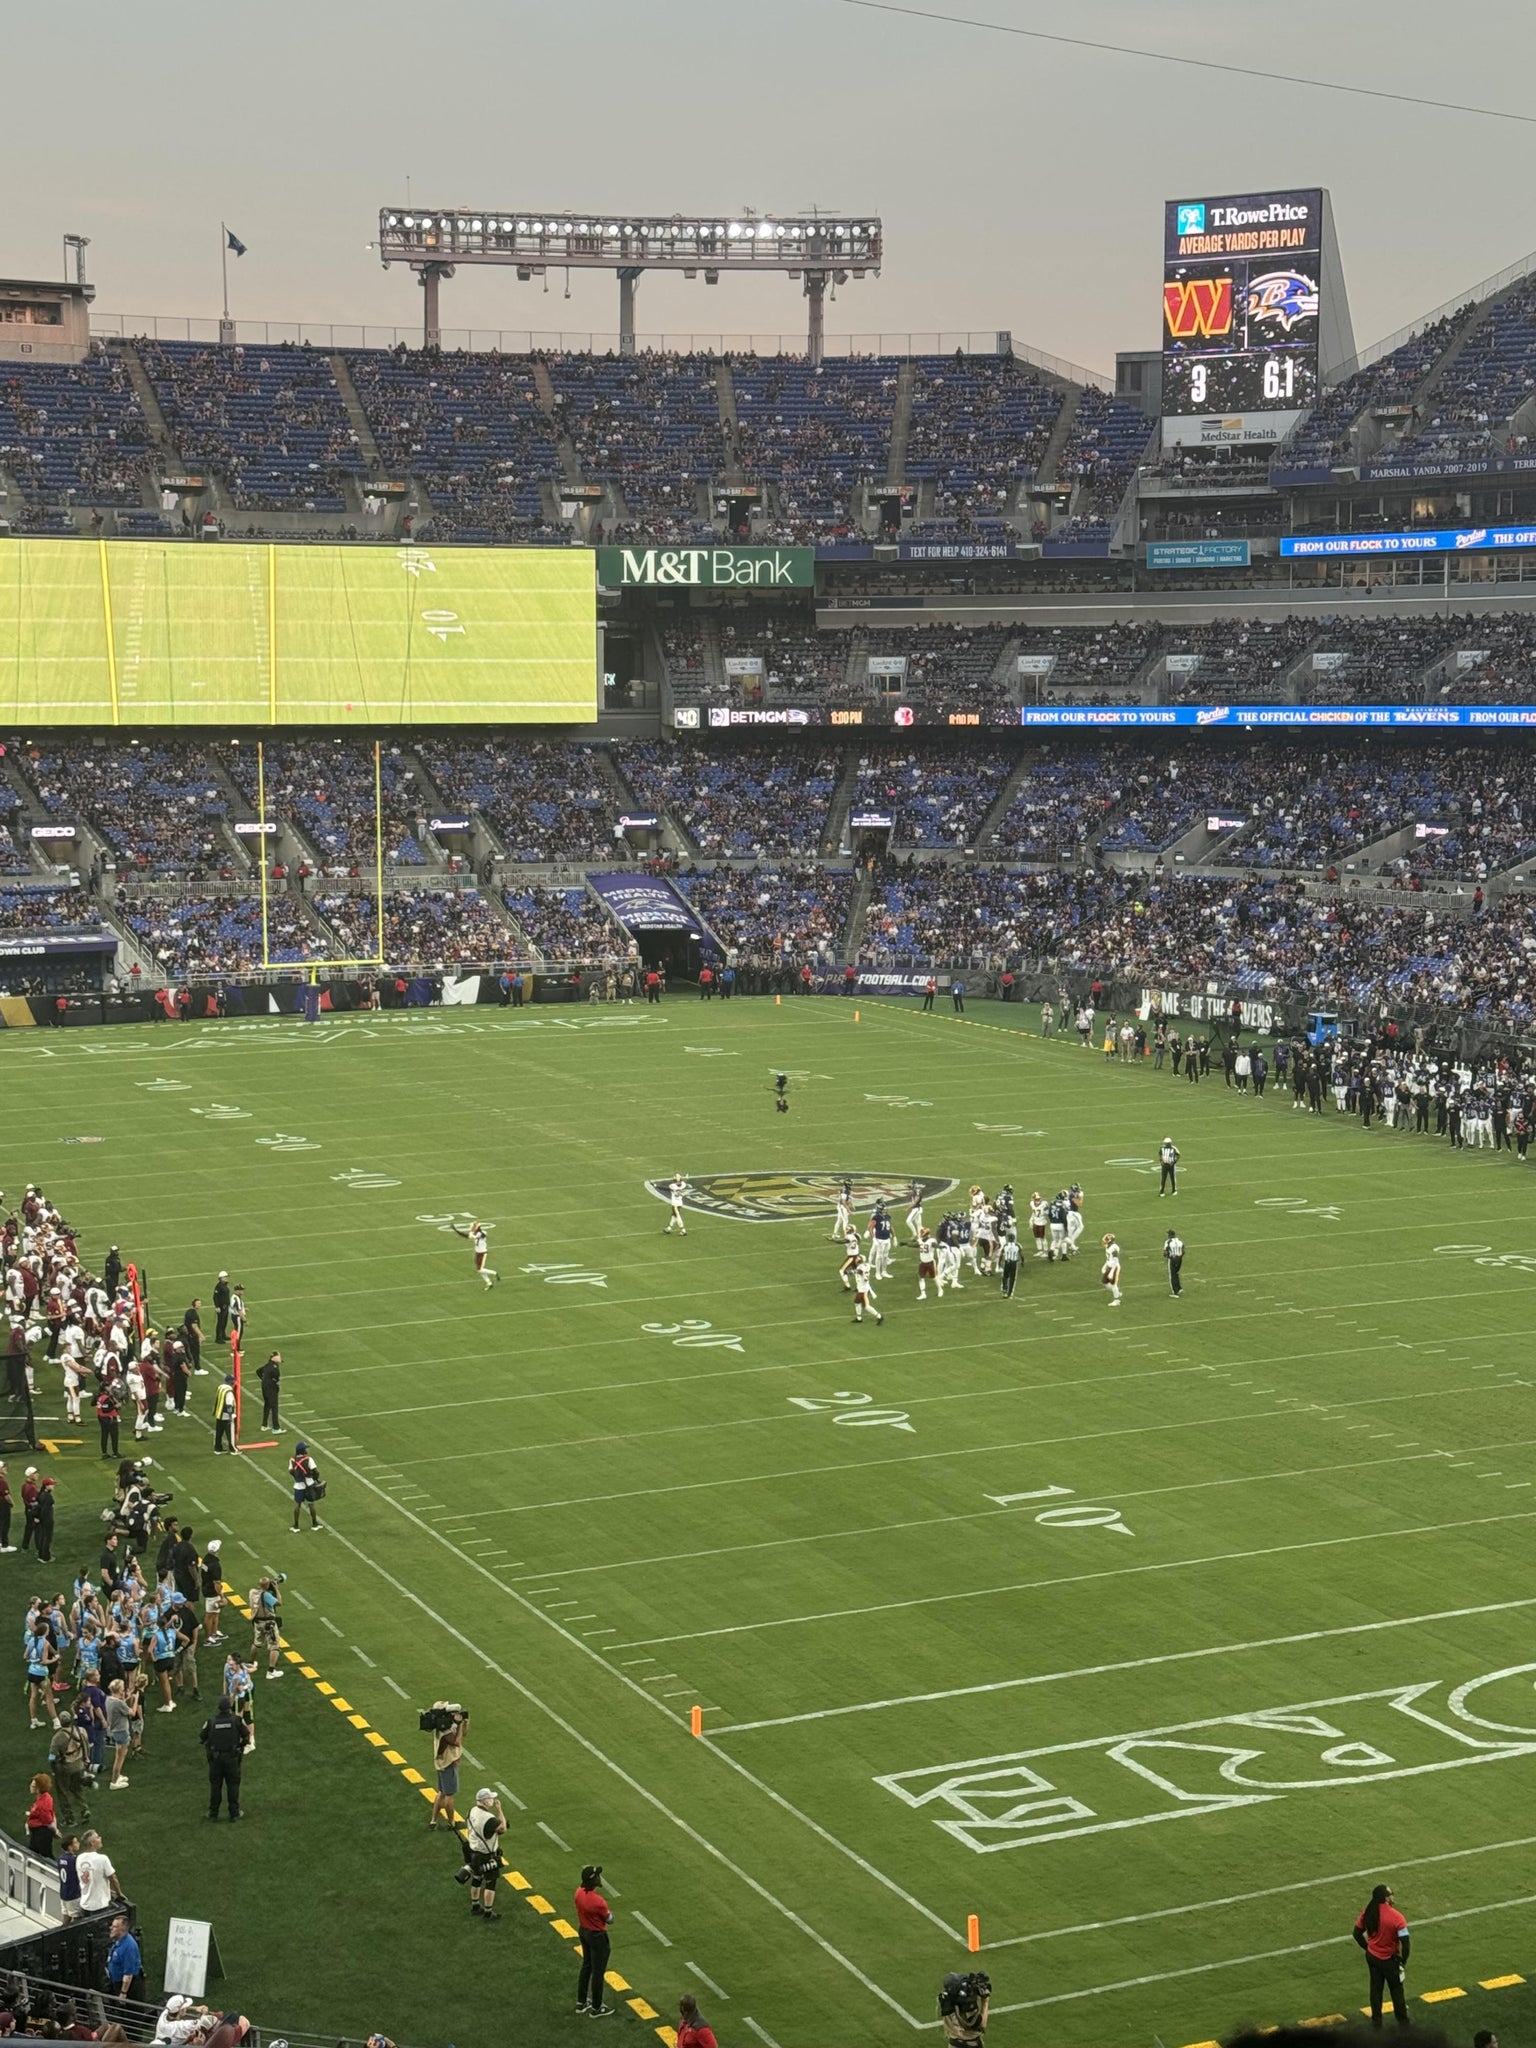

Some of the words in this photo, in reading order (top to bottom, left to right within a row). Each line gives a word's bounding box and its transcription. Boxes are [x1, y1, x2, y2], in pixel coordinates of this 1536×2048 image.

[1179, 235, 1224, 255] AVERAGE
[1224, 232, 1258, 252] YARDS
[1260, 230, 1278, 249] PER
[1280, 228, 1306, 247] PLAY
[1191, 364, 1207, 403] 3
[1264, 359, 1294, 399] 6.1
[1200, 430, 1242, 442] MedStar
[1243, 428, 1278, 440] Health
[1370, 466, 1411, 479] MARSHAL
[1413, 464, 1442, 476] YANDA
[1444, 462, 1488, 474] 2007-2019
[1294, 541, 1324, 552] FROM
[1325, 540, 1348, 551] OUR
[1350, 539, 1382, 550] FLOCK
[1384, 538, 1400, 549] TO
[1401, 537, 1437, 548] YOURS
[1456, 530, 1487, 548] Perdue
[1492, 532, 1514, 544] THE
[910, 547, 928, 558] TEXT
[928, 546, 941, 558] FOR
[942, 546, 959, 558] HELP
[1153, 547, 1198, 555] STRATEGIC
[1204, 546, 1242, 554] FACTORY
[620, 550, 708, 584] M&T
[712, 550, 794, 585] Bank
[677, 709, 698, 726] 40
[730, 711, 787, 723] BETMGM
[1026, 712, 1059, 722] FROM
[1060, 712, 1086, 722] OUR
[1087, 712, 1120, 722] FLOCK
[1122, 712, 1138, 722] TO
[1139, 712, 1176, 722] YOURS
[1196, 706, 1230, 725] Perdue
[1236, 712, 1258, 722] THE
[1259, 712, 1308, 722] OFFICIAL
[1310, 712, 1354, 722] CHICKEN
[1355, 712, 1368, 722] OF
[1370, 712, 1390, 722] THE
[1393, 712, 1460, 722] RAVENS
[1470, 712, 1496, 722] FROM
[1498, 712, 1520, 722] OUR
[31, 827, 76, 838] GEICO
[235, 823, 276, 833] GEICO
[602, 888, 670, 898] MEDSTAR
[612, 892, 670, 900] HEALTH
[620, 912, 689, 921] MEDSTAR
[630, 916, 688, 924] HEALTH
[21, 946, 46, 954] CLUB
[1190, 994, 1203, 1018] OF
[1206, 996, 1226, 1020] THE
[0, 1014, 668, 1057] RAVENS
[255, 1135, 322, 1150] 30
[330, 1172, 402, 1188] 40
[519, 1263, 608, 1284] 40
[640, 1320, 742, 1347] 30
[786, 1391, 910, 1426] 20
[982, 1485, 1122, 1527] 10
[60, 1868, 67, 1884] 0
